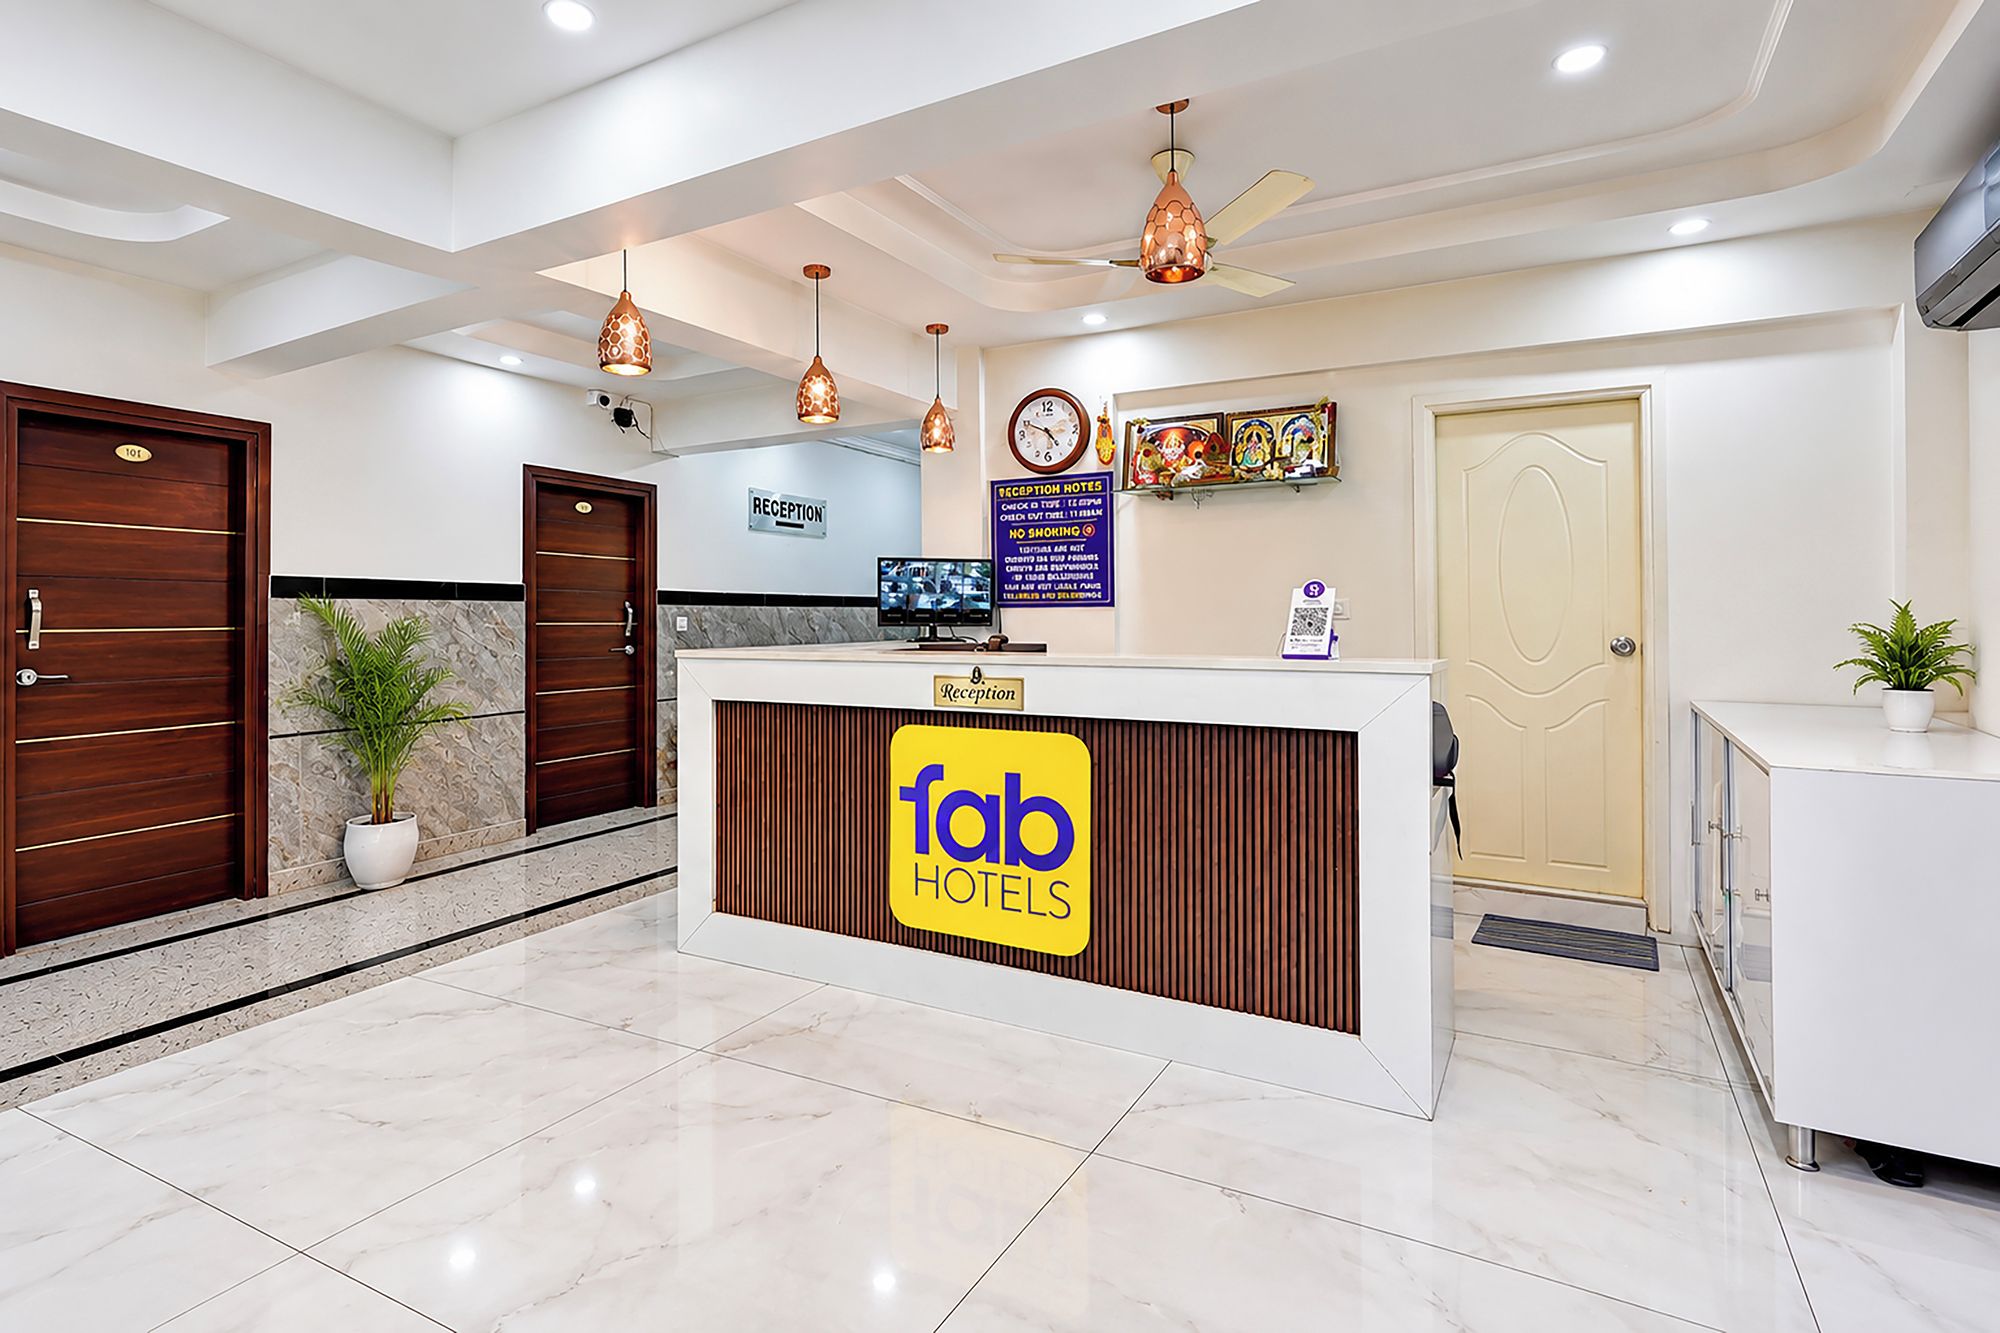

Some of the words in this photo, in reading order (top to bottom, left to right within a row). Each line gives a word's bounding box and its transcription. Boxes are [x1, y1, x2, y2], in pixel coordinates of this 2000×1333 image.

[1042, 400, 1053, 412] 12
[1044, 451, 1052, 462] 6
[753, 496, 822, 523] RECEPTION
[1009, 528, 1026, 539] NO
[940, 683, 1016, 704] Reception
[899, 764, 1075, 872] fab
[915, 862, 1071, 919] HOTELS
